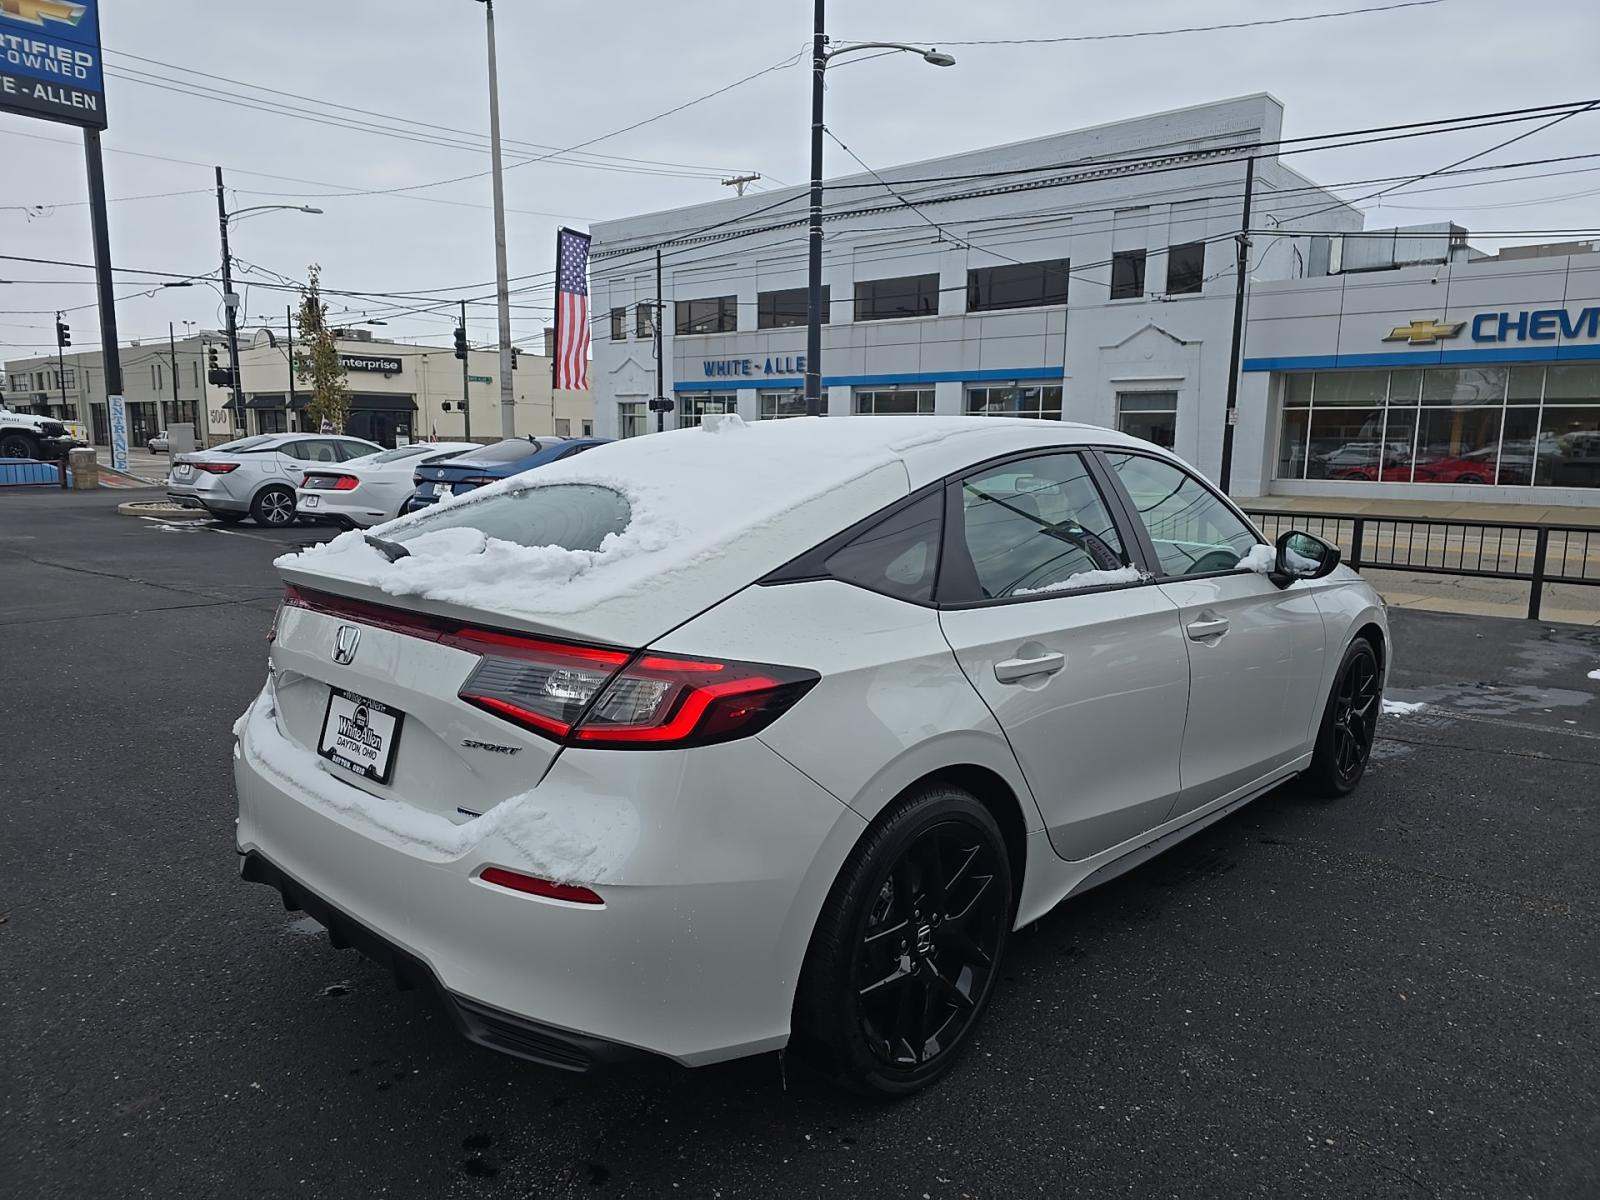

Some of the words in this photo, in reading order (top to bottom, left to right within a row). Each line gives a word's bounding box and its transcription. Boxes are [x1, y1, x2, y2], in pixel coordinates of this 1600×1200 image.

[0, 75, 97, 111] E-ALLEN
[703, 356, 807, 377] WHITE-ALLE
[210, 410, 227, 424] 500
[111, 398, 127, 470] ENTRANCE
[362, 746, 378, 761] OHIO
[461, 739, 522, 755] SPORT
